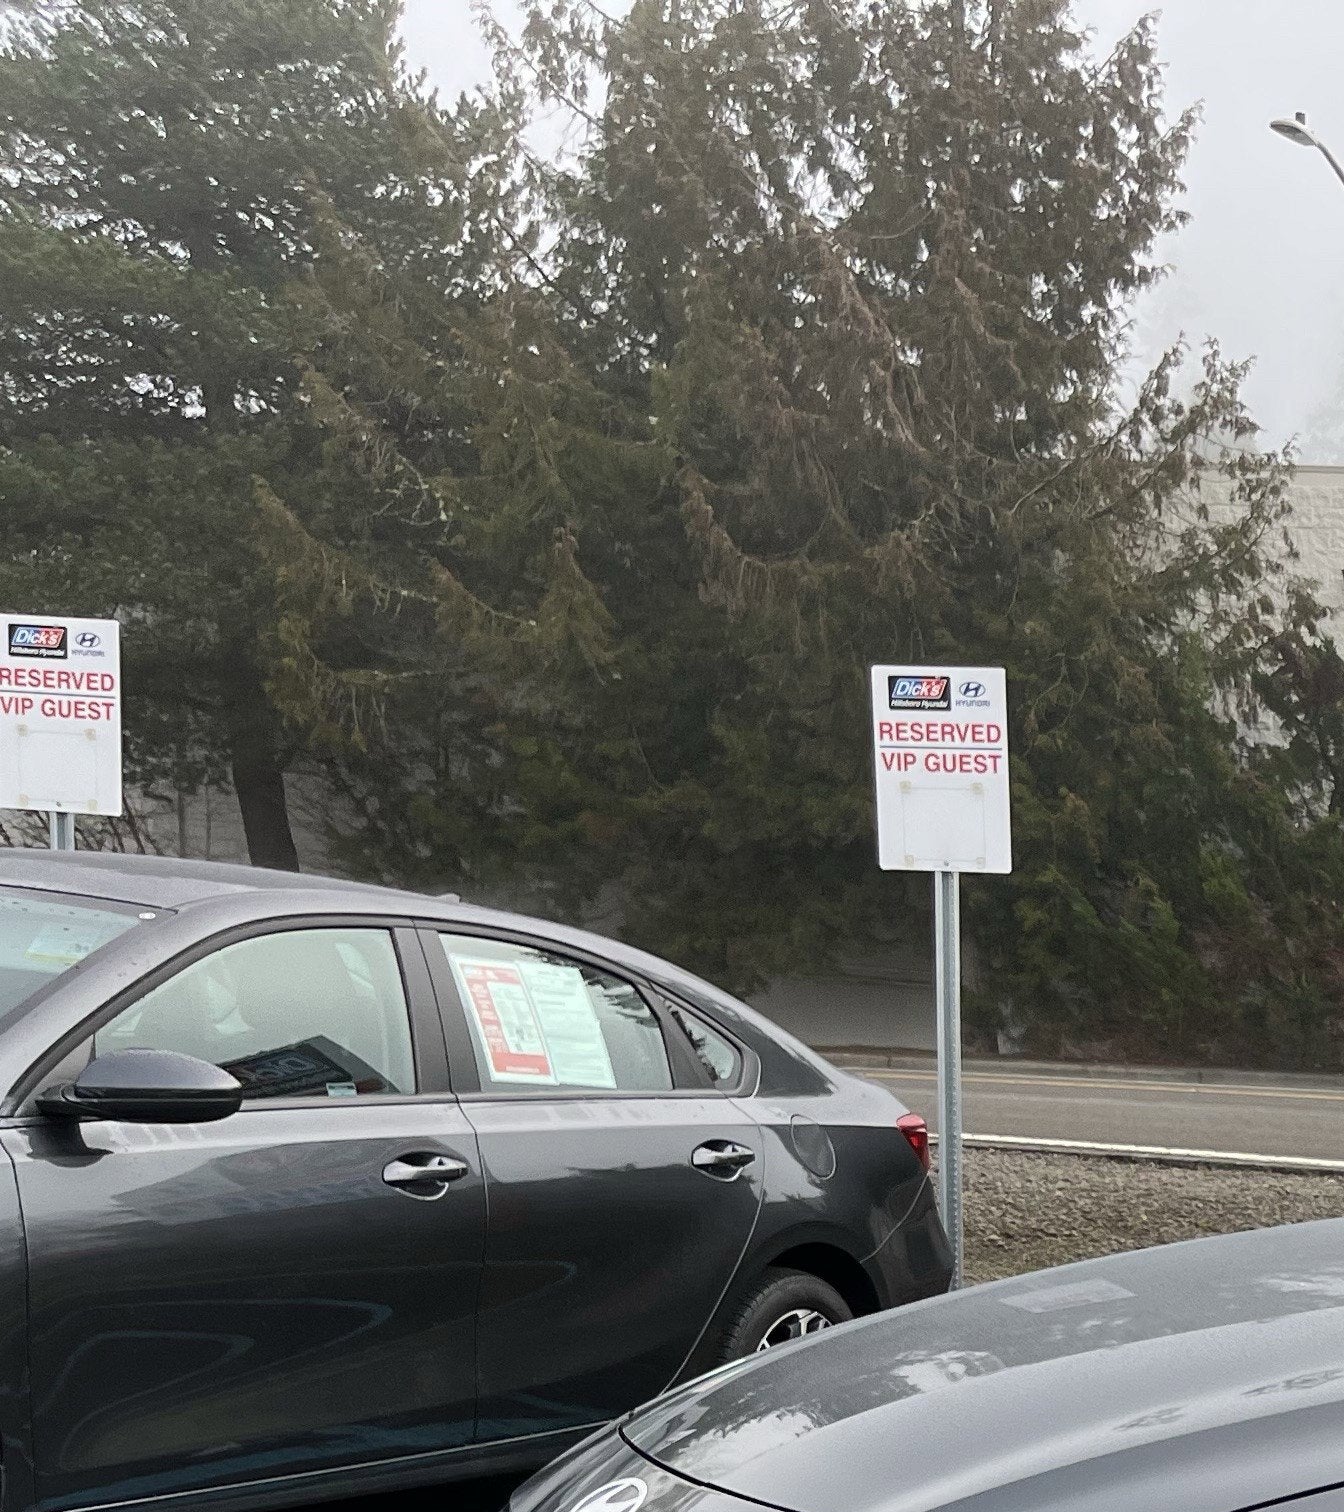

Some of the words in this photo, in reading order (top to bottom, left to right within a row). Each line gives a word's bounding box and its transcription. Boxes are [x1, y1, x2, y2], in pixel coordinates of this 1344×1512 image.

[15, 628, 58, 645] Dick's
[0, 667, 115, 692] RESERVED
[897, 680, 942, 697] Dick's
[1, 696, 34, 715] VIP
[41, 699, 115, 720] GUEST
[879, 721, 1002, 744] RESERVED
[881, 752, 917, 772] VIP
[924, 754, 1003, 774] GUEST
